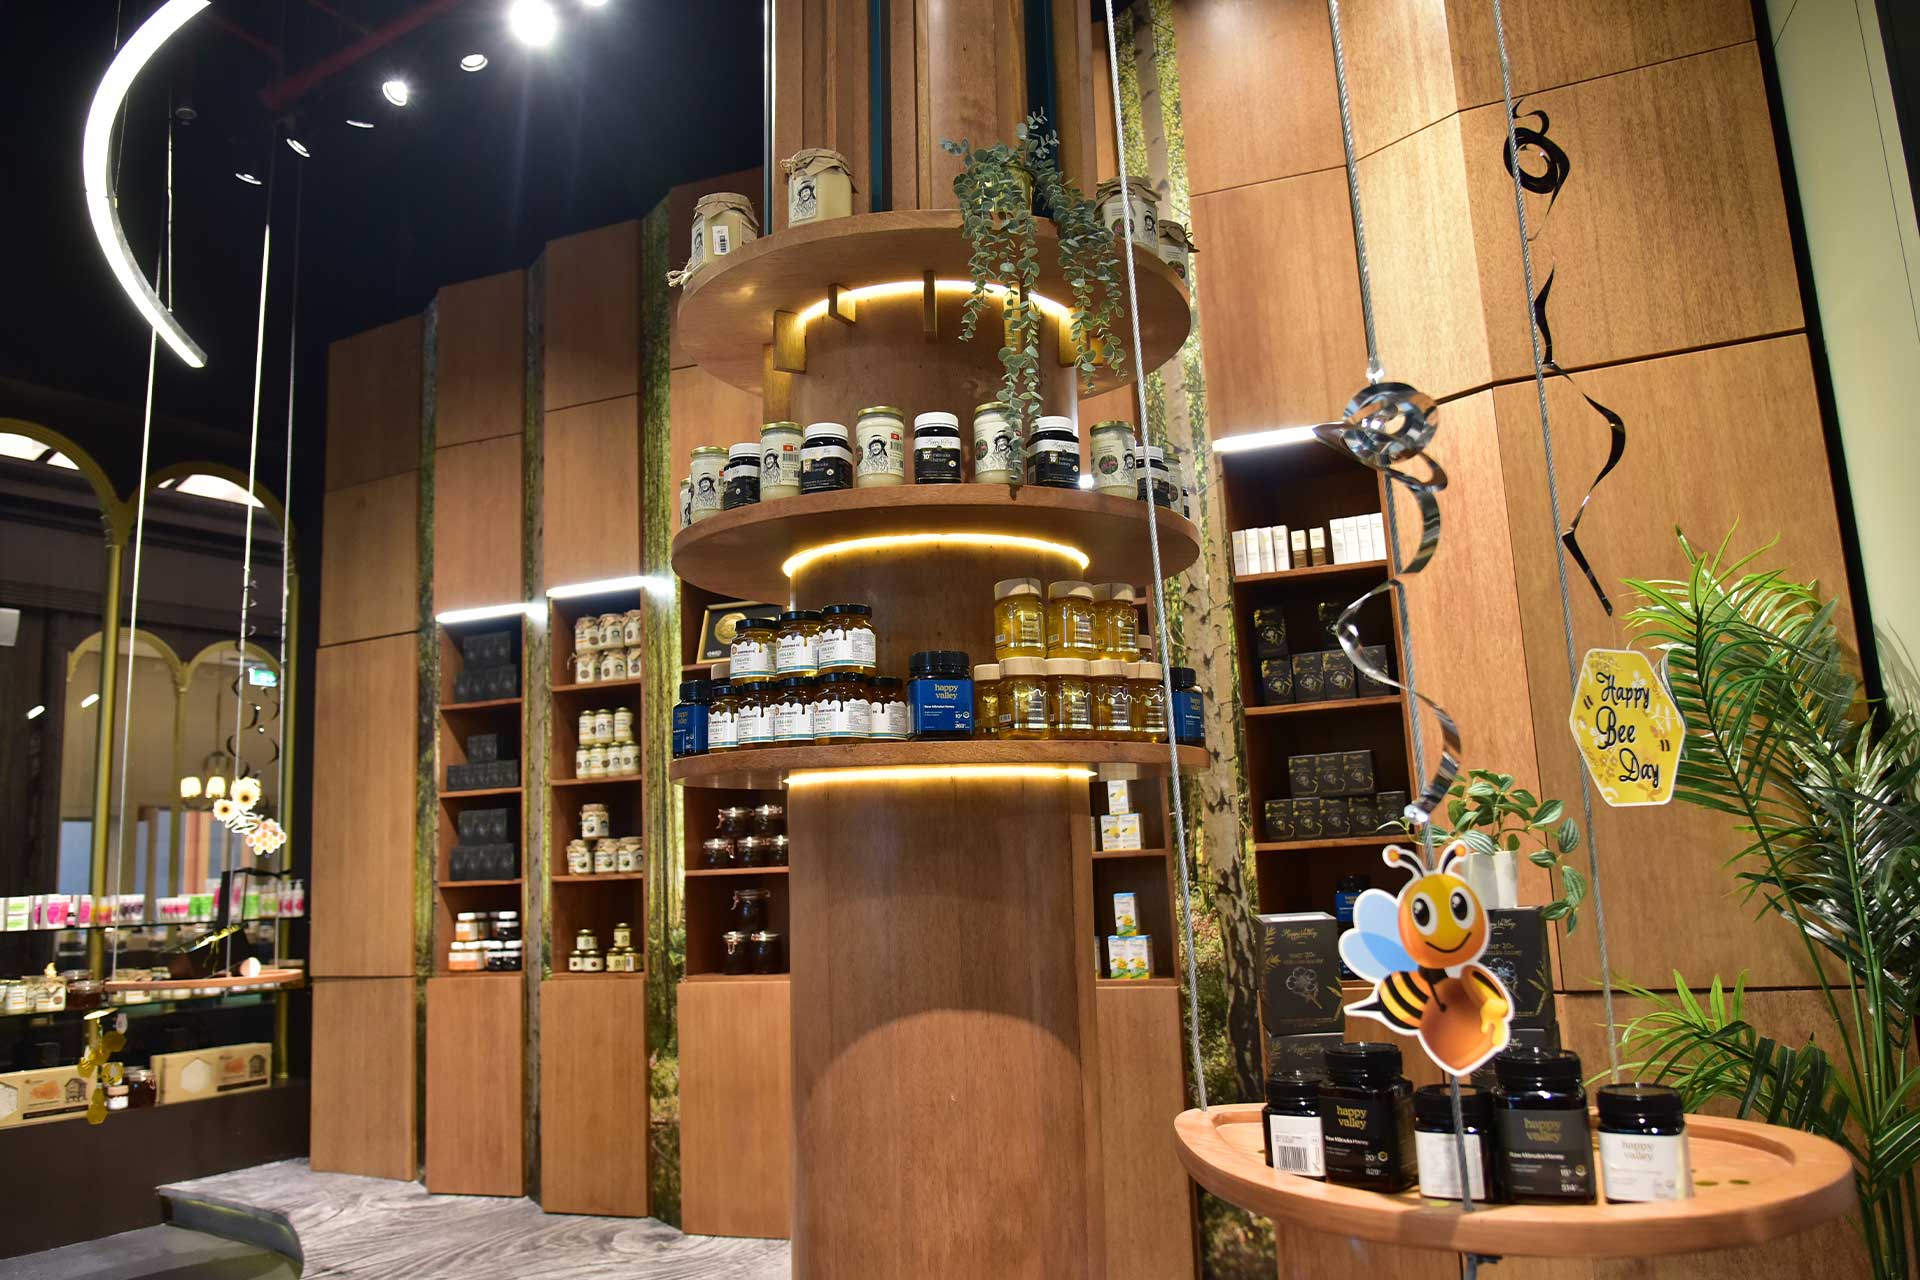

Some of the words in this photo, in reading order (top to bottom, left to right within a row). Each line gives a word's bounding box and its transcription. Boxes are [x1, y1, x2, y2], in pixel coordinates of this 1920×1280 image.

[934, 684, 958, 692] happy
[1596, 672, 1650, 708] Happy
[936, 691, 957, 700] valley
[1596, 706, 1636, 750] Bee
[1619, 748, 1660, 788] Day
[1336, 1105, 1367, 1119] happy
[1338, 1116, 1366, 1130] valley
[1524, 1118, 1560, 1132] happy
[1527, 1131, 1562, 1144] valley
[1622, 1141, 1654, 1152] happy
[1624, 1152, 1654, 1160] valley
